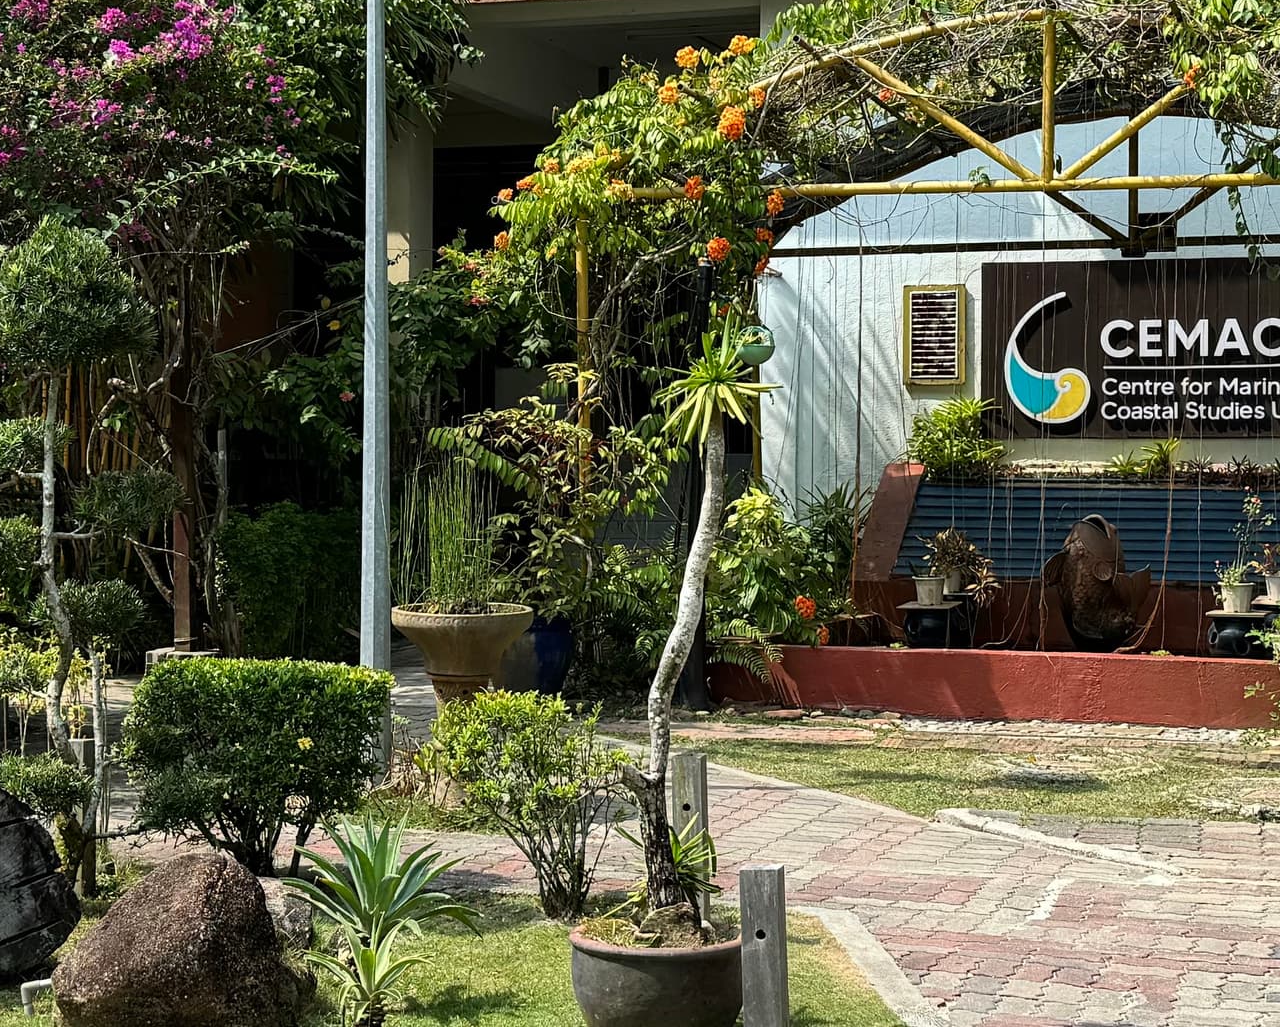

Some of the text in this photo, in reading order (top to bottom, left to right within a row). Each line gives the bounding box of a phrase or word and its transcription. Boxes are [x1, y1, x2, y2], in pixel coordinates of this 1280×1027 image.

[1101, 377, 1177, 396] Centre
[1180, 376, 1214, 396] for
[1100, 401, 1179, 421] Coastal
[1185, 400, 1266, 420] Studies
